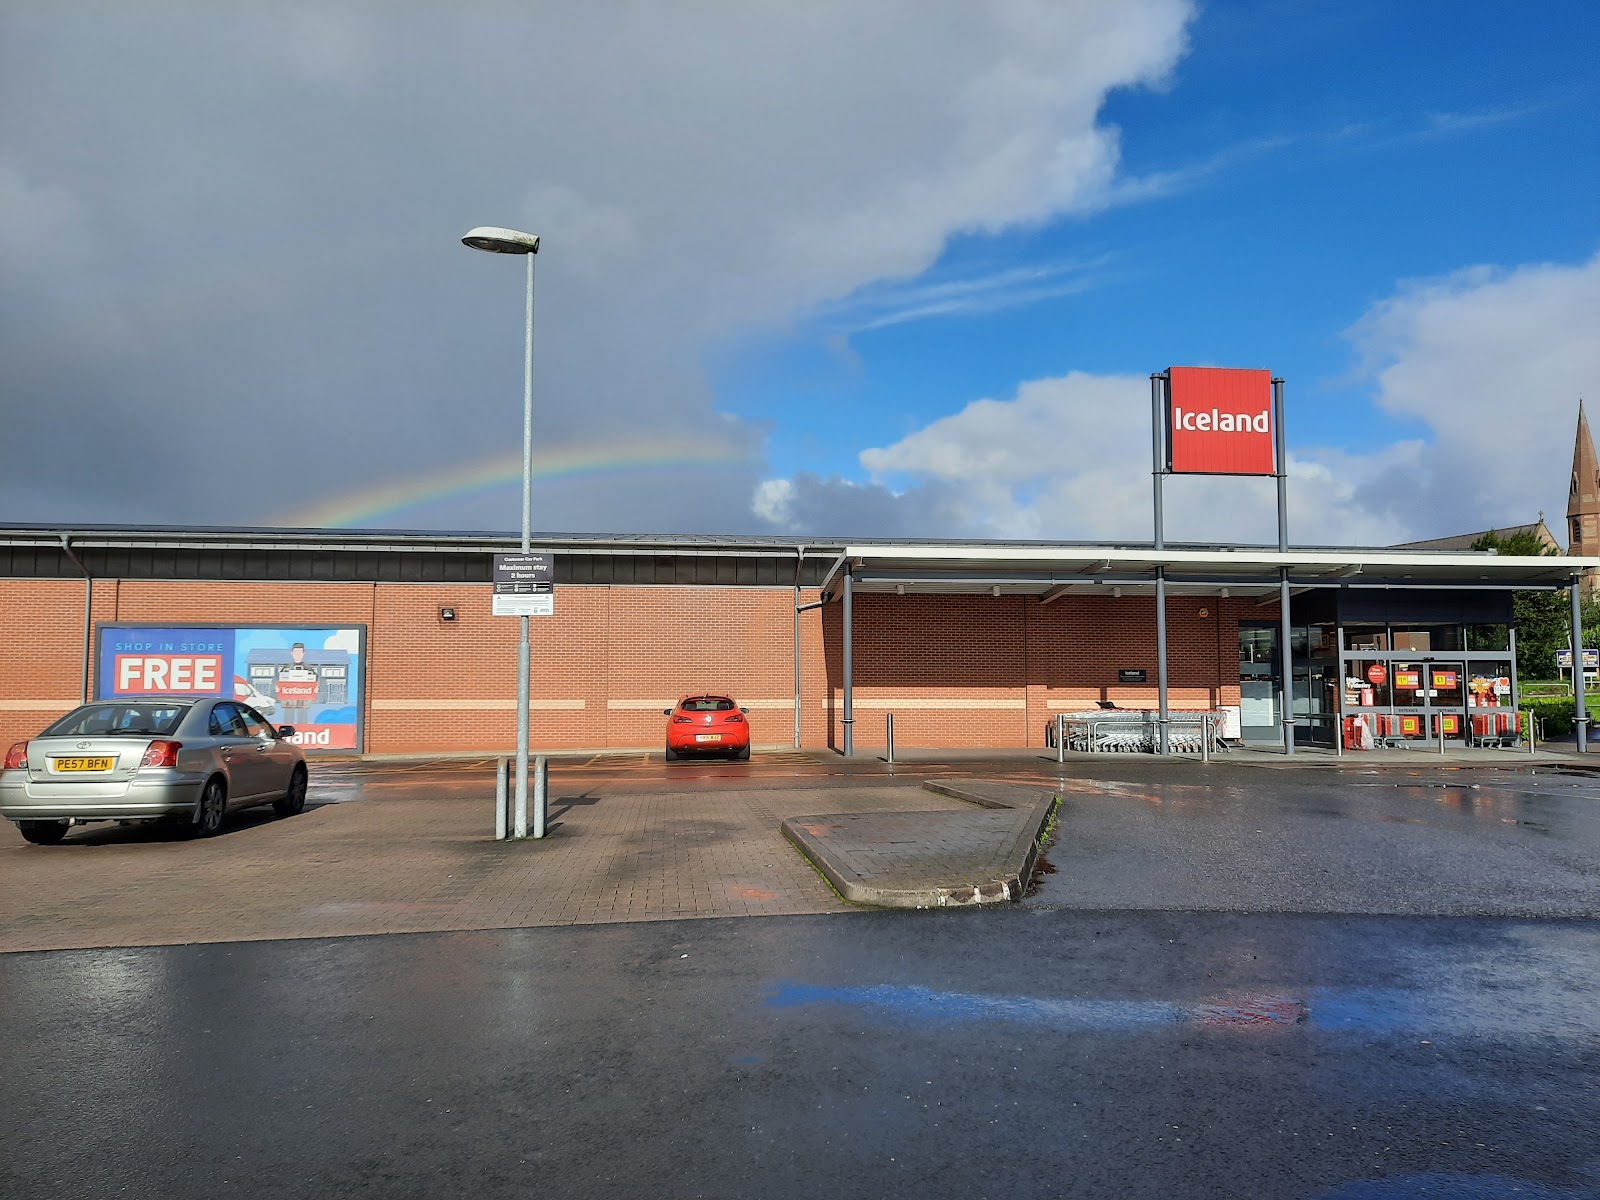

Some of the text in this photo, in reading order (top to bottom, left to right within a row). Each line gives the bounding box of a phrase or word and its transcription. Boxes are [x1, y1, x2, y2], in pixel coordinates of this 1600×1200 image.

[1175, 407, 1269, 433] Iceland
[115, 642, 224, 652] SHOP IN STORE
[119, 657, 217, 690] FREE
[281, 686, 312, 695] Iceland
[57, 759, 108, 769] PE57 BFN
